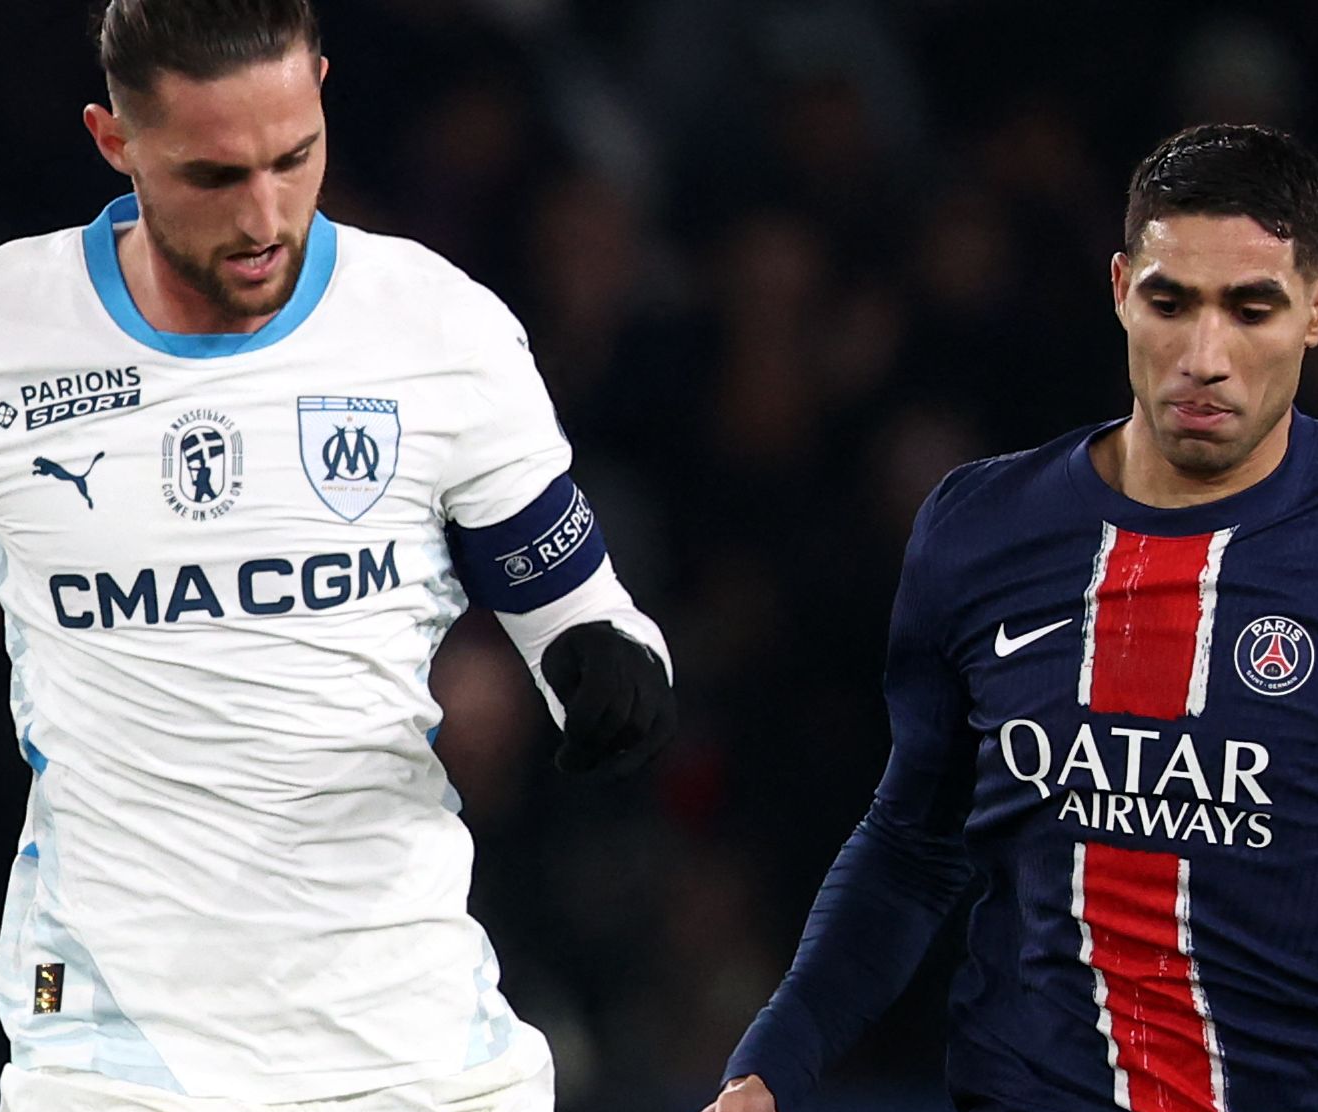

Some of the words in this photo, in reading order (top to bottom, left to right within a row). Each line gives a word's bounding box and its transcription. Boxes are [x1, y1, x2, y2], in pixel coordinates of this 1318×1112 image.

[20, 366, 141, 407] PARIONS
[30, 391, 137, 428] SPORT
[538, 489, 591, 564] RESPEC
[49, 568, 225, 629] CMA
[237, 540, 401, 615] CGM
[1250, 620, 1303, 642] PARIS
[1000, 719, 1273, 805] QATAR
[1057, 790, 1273, 848] AIRWAYS
